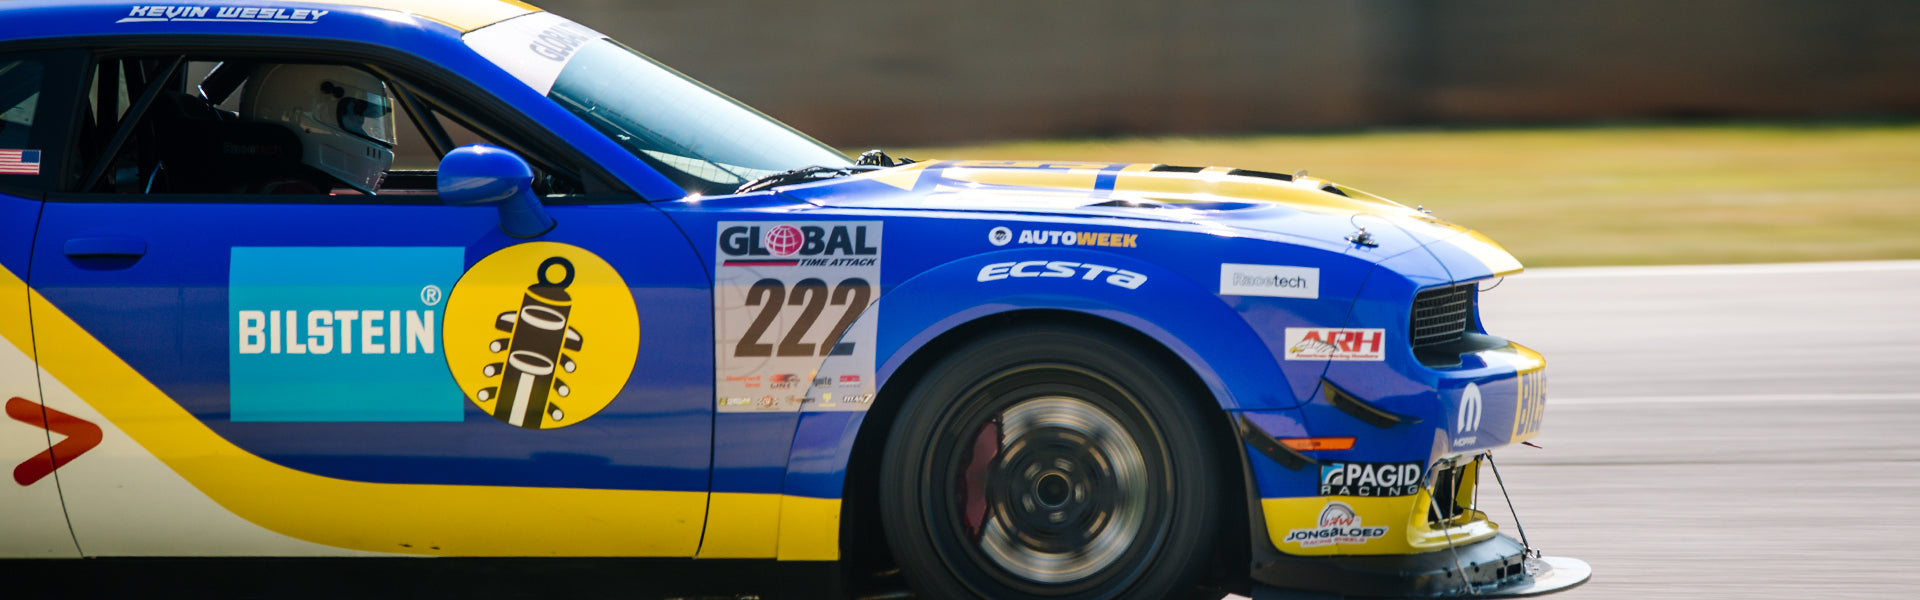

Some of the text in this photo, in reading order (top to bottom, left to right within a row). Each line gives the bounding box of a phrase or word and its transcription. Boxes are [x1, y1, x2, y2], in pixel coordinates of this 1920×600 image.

[128, 5, 329, 20] KEVIN WESLEY
[719, 224, 878, 257] GLOBAL
[1018, 229, 1139, 248] AUTOWEEK
[800, 258, 878, 267] TIME ATTACK
[733, 277, 872, 358] 222
[238, 310, 435, 355] BILSTEIN
[1301, 330, 1383, 353] ARH
[1346, 462, 1421, 488] PAGID
[1320, 484, 1419, 497] RACING
[1286, 527, 1385, 541] JONGBLOED
